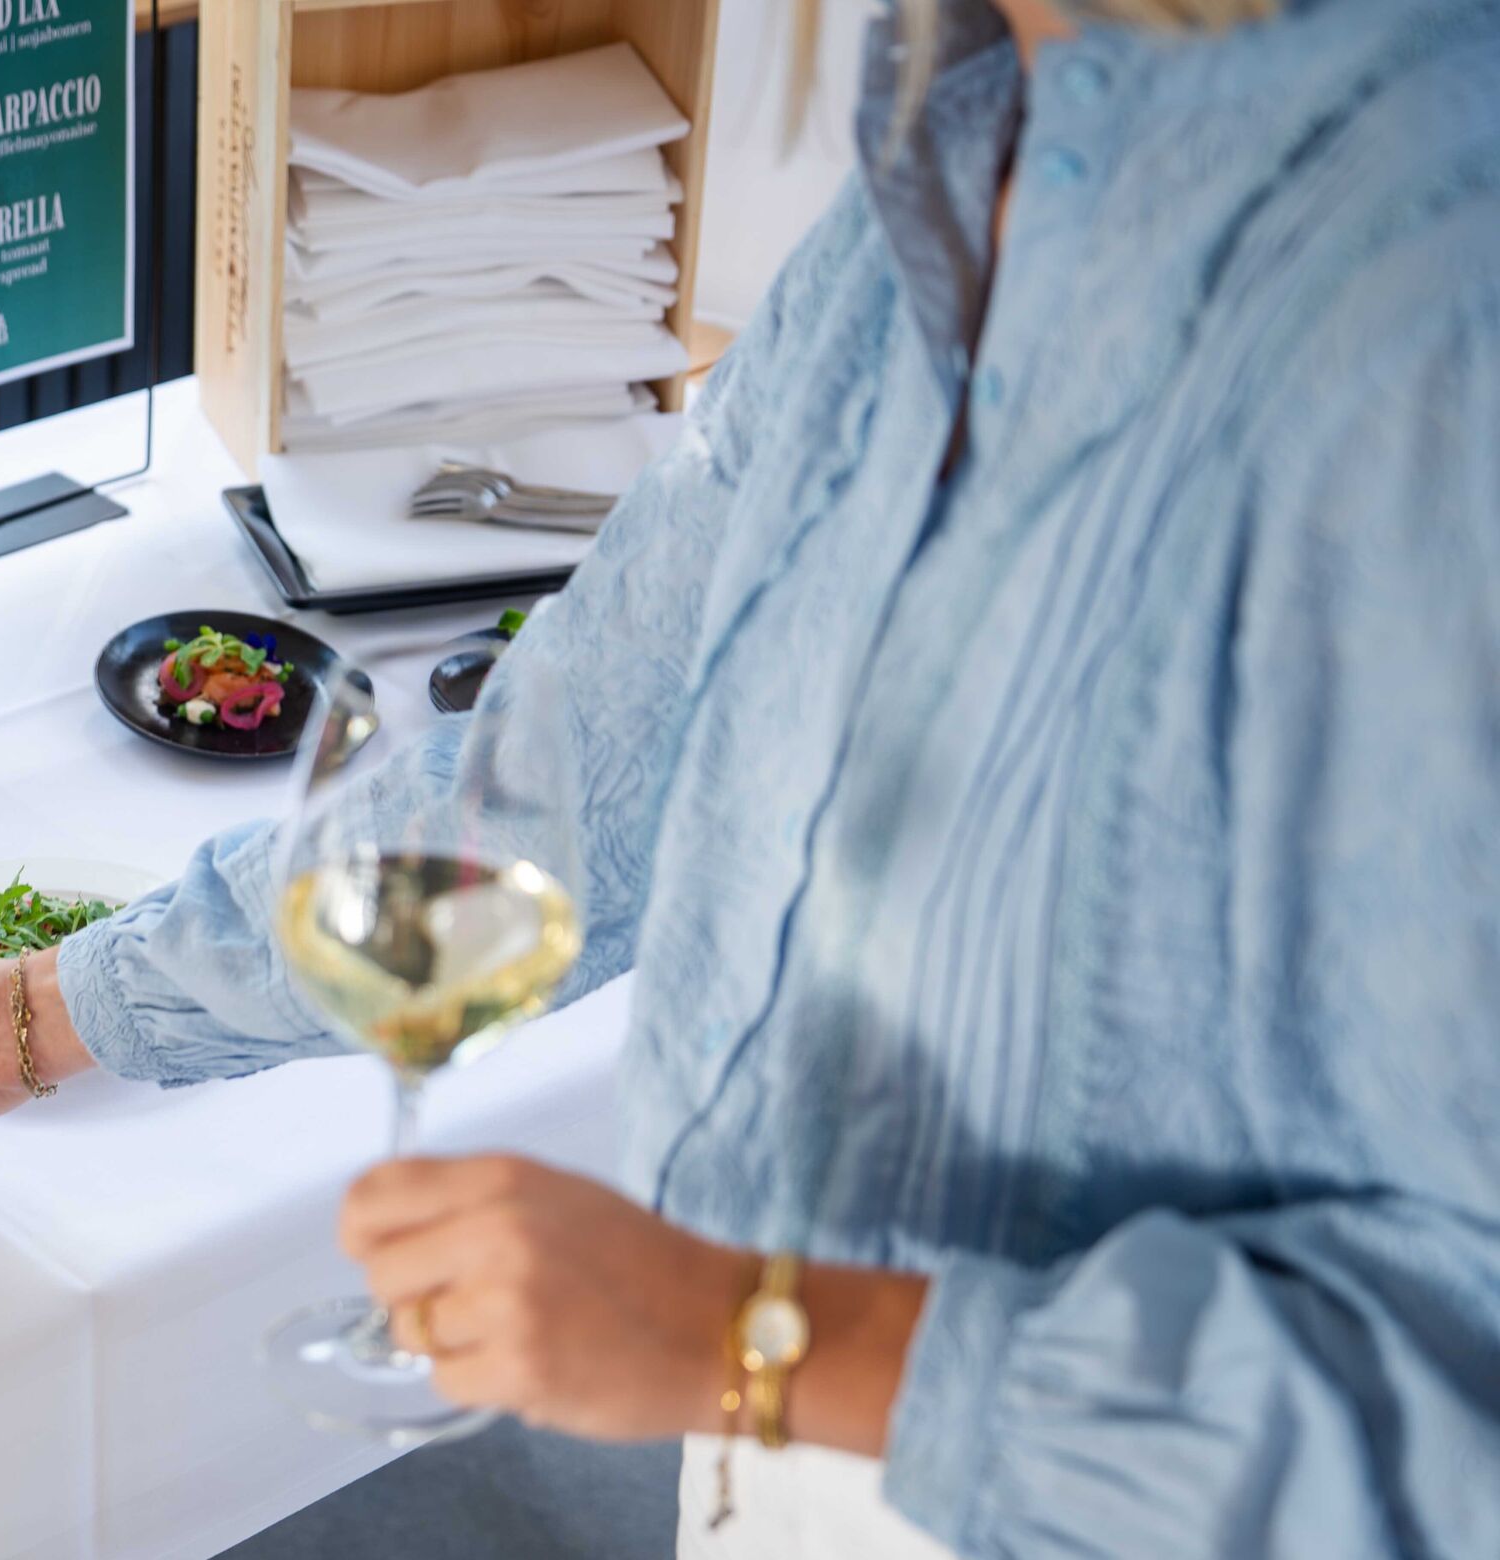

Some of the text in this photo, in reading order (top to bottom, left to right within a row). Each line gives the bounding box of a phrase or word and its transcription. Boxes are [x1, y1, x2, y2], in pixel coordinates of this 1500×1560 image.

[18, 19, 92, 49] sojabonen
[0, 238, 50, 263] tomaat
[0, 256, 48, 287] spread
